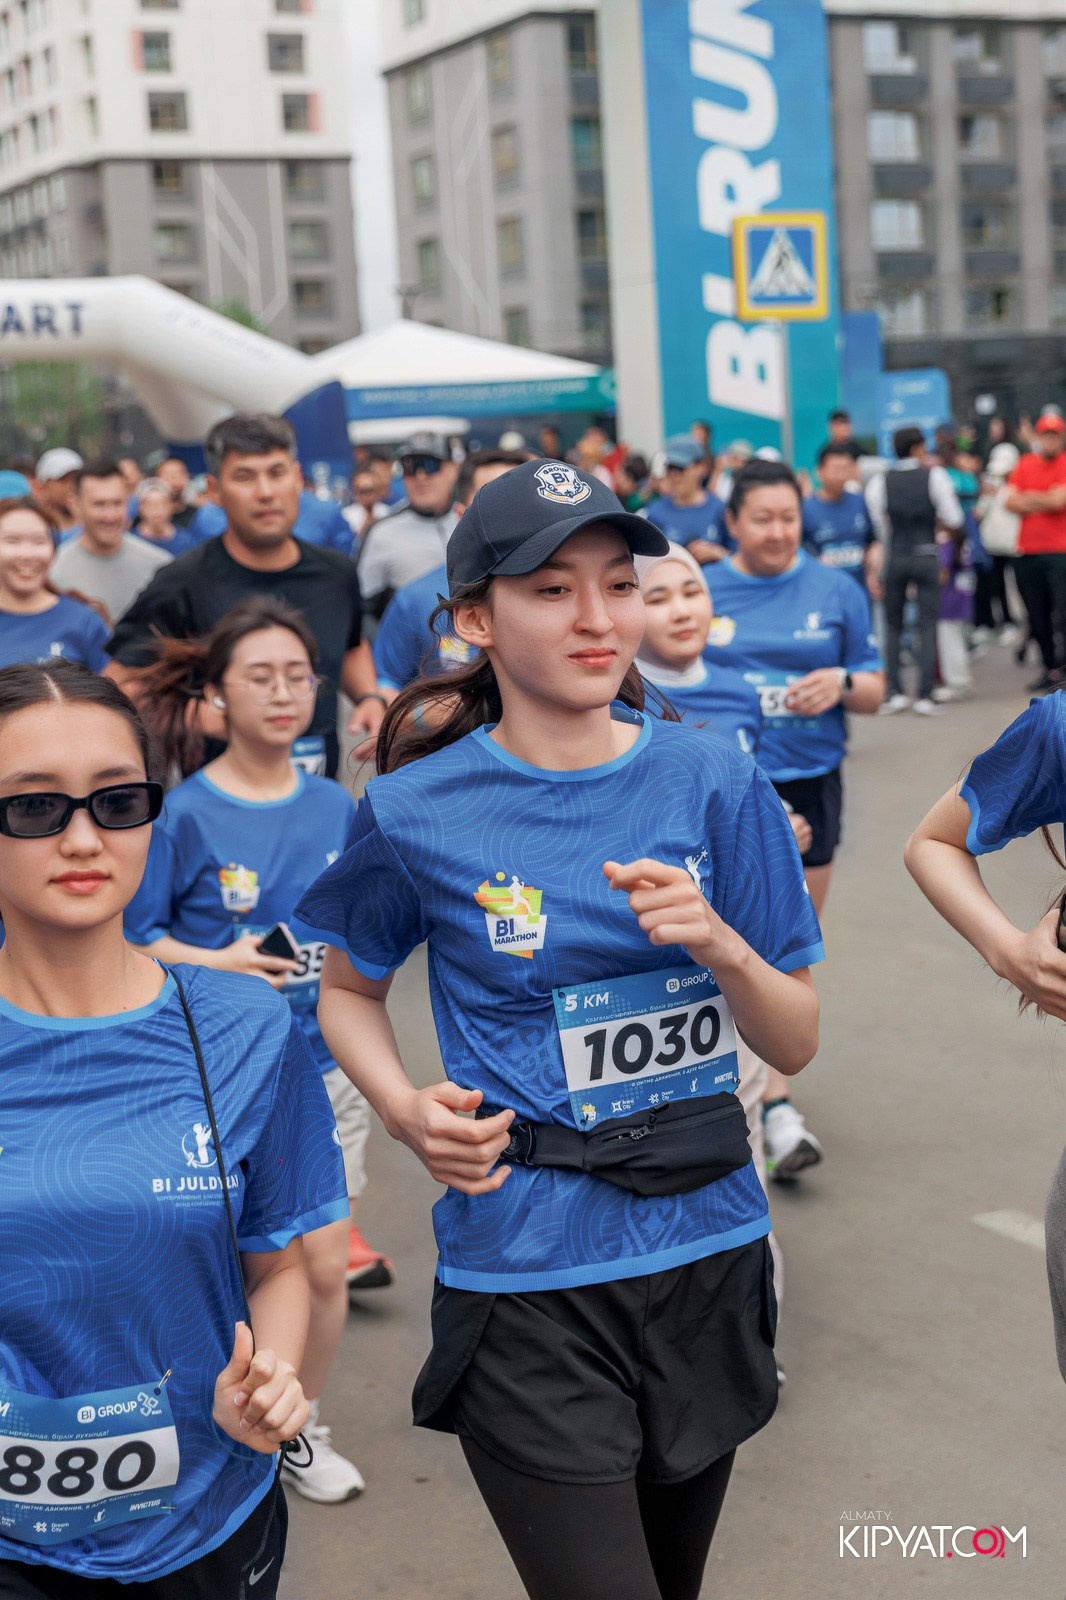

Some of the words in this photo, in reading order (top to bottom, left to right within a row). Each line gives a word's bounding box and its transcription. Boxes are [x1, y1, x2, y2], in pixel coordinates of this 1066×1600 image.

[543, 466, 569, 475] GROUP
[551, 473, 570, 484] BI
[496, 918, 515, 937] BI
[494, 931, 538, 946] MARATHON
[681, 972, 709, 988] GROUP
[564, 993, 579, 1012] 5
[583, 991, 610, 1009] KM
[584, 1004, 721, 1082] 1030
[152, 1178, 171, 1193] BI
[81, 1410, 92, 1420] BI
[97, 1400, 138, 1418] GROUP
[129, 1498, 162, 1512] INVICTUS
